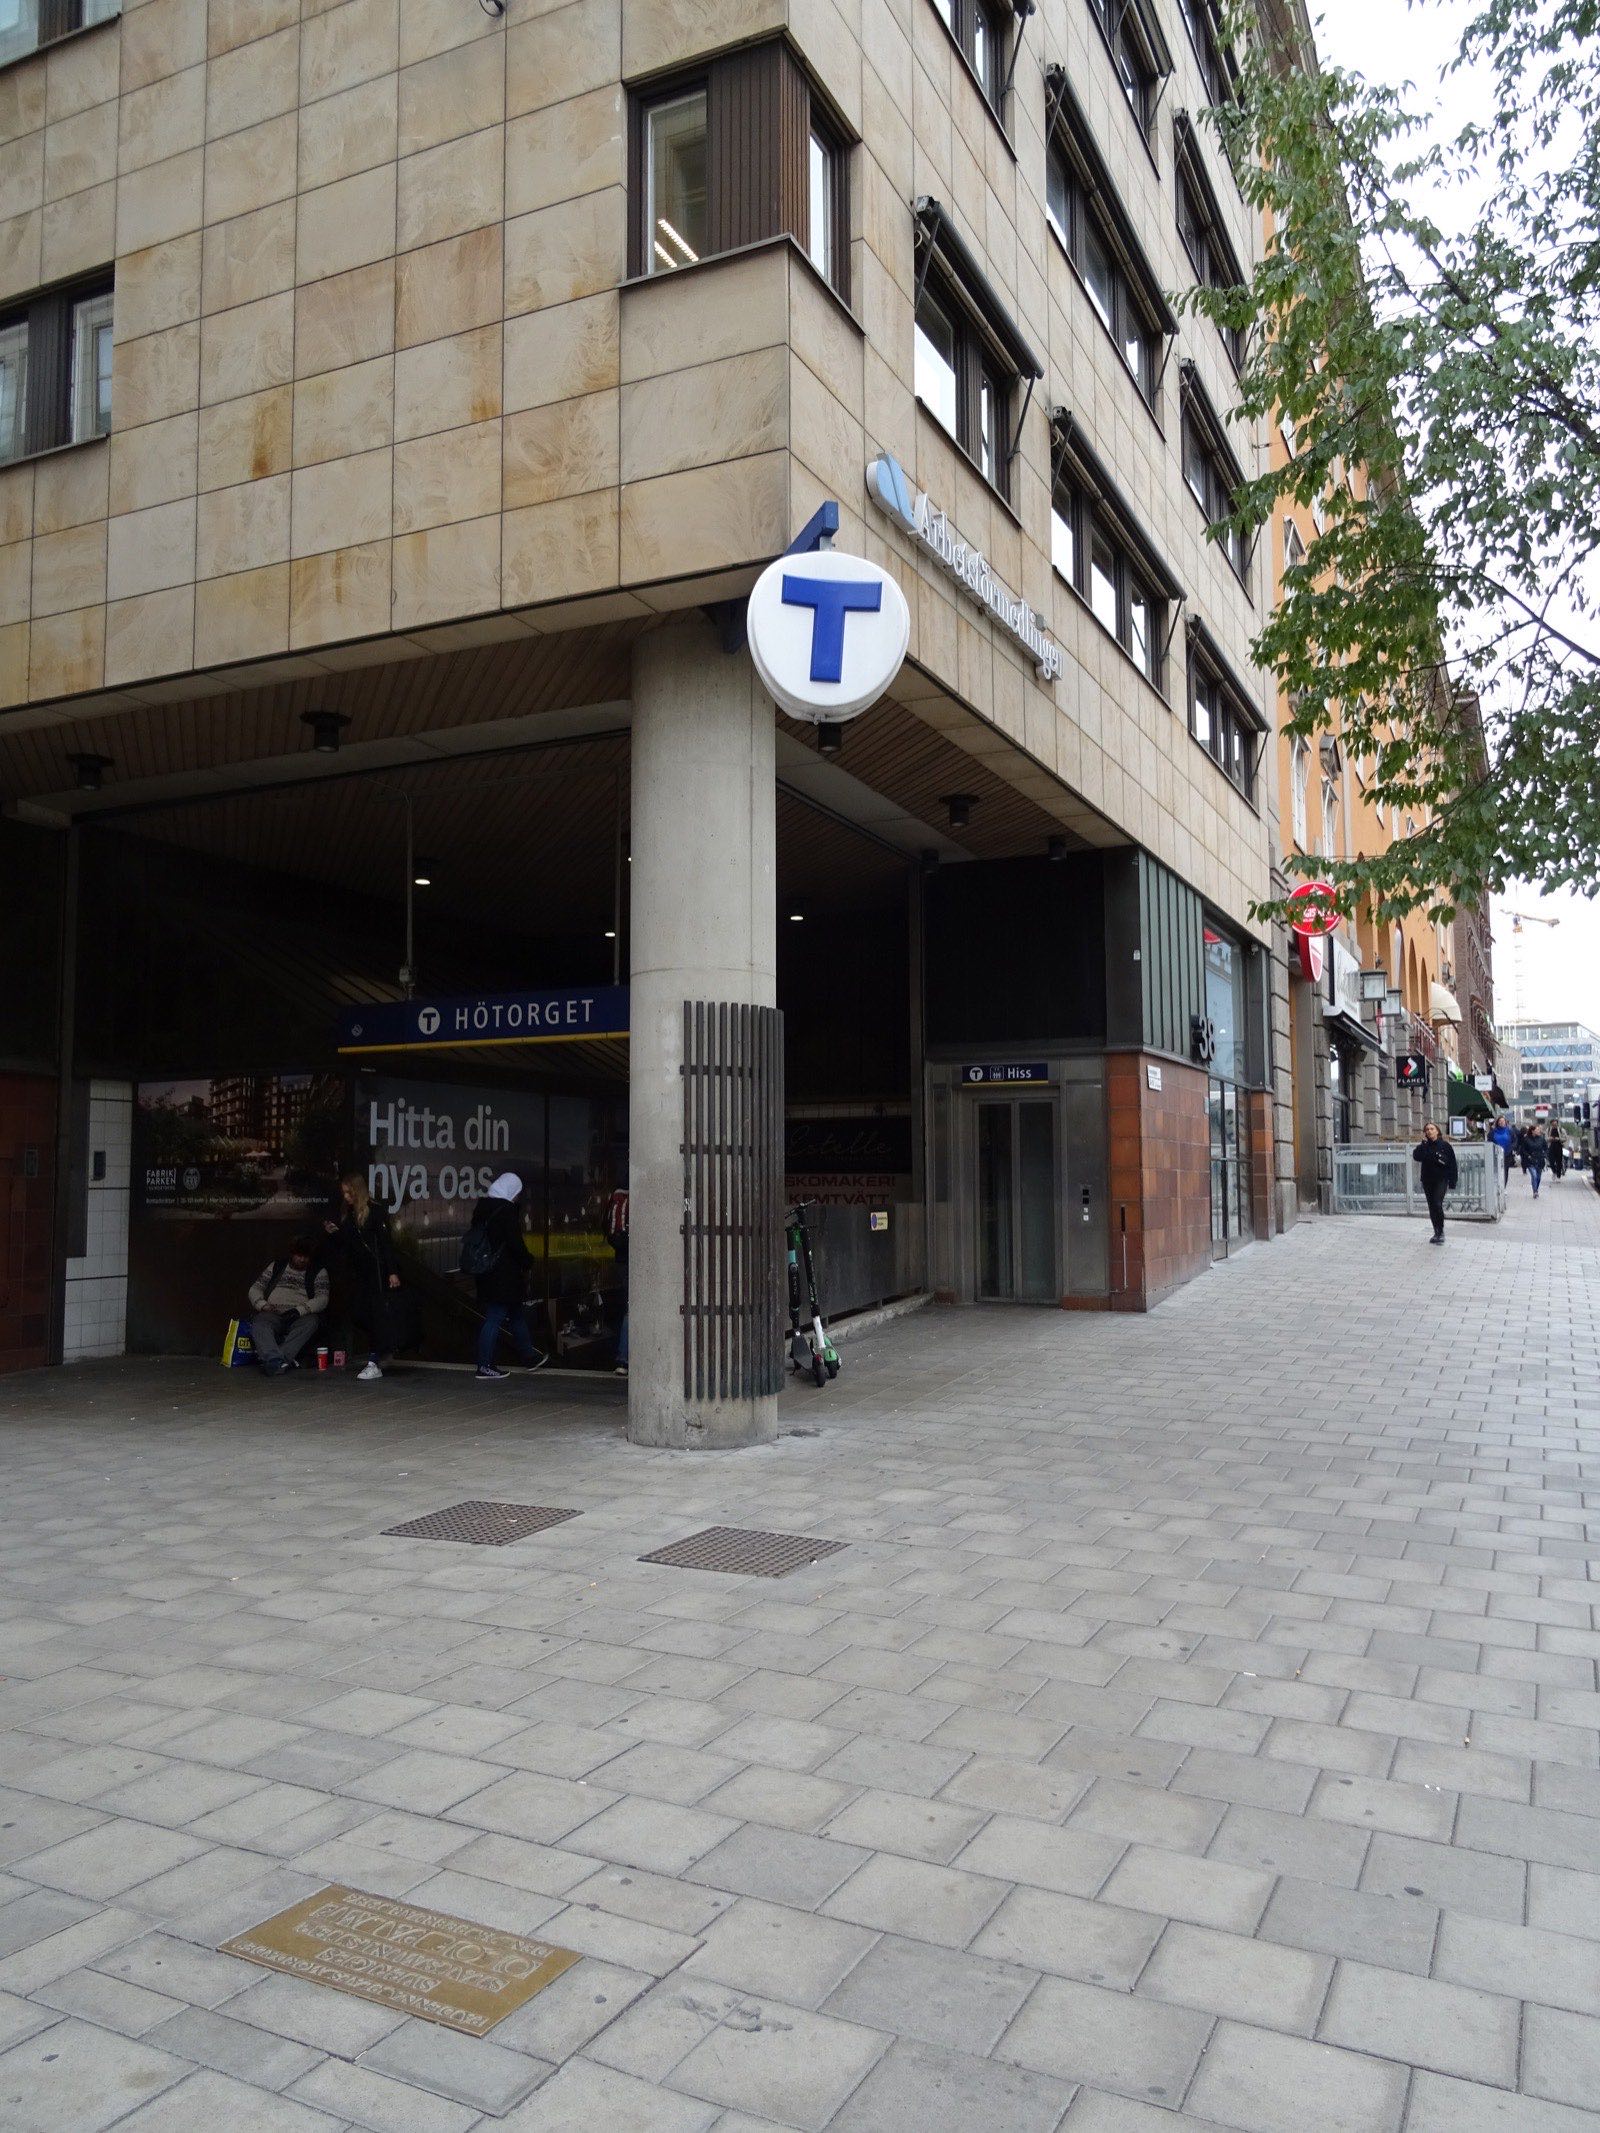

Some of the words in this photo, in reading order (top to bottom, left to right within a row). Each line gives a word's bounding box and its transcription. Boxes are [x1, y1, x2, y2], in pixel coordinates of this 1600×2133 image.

[918, 493, 1064, 681] Arbetsförmedlingen
[781, 573, 883, 684] T
[455, 998, 594, 1031] HÖTORGET
[1197, 1014, 1216, 1062] 38
[1008, 1067, 1032, 1079] Hiss
[369, 1098, 456, 1150] Hitta
[464, 1104, 510, 1152] din
[146, 1178, 176, 1186] PARKEN
[368, 1161, 431, 1215] nya
[438, 1164, 494, 1200] oas
